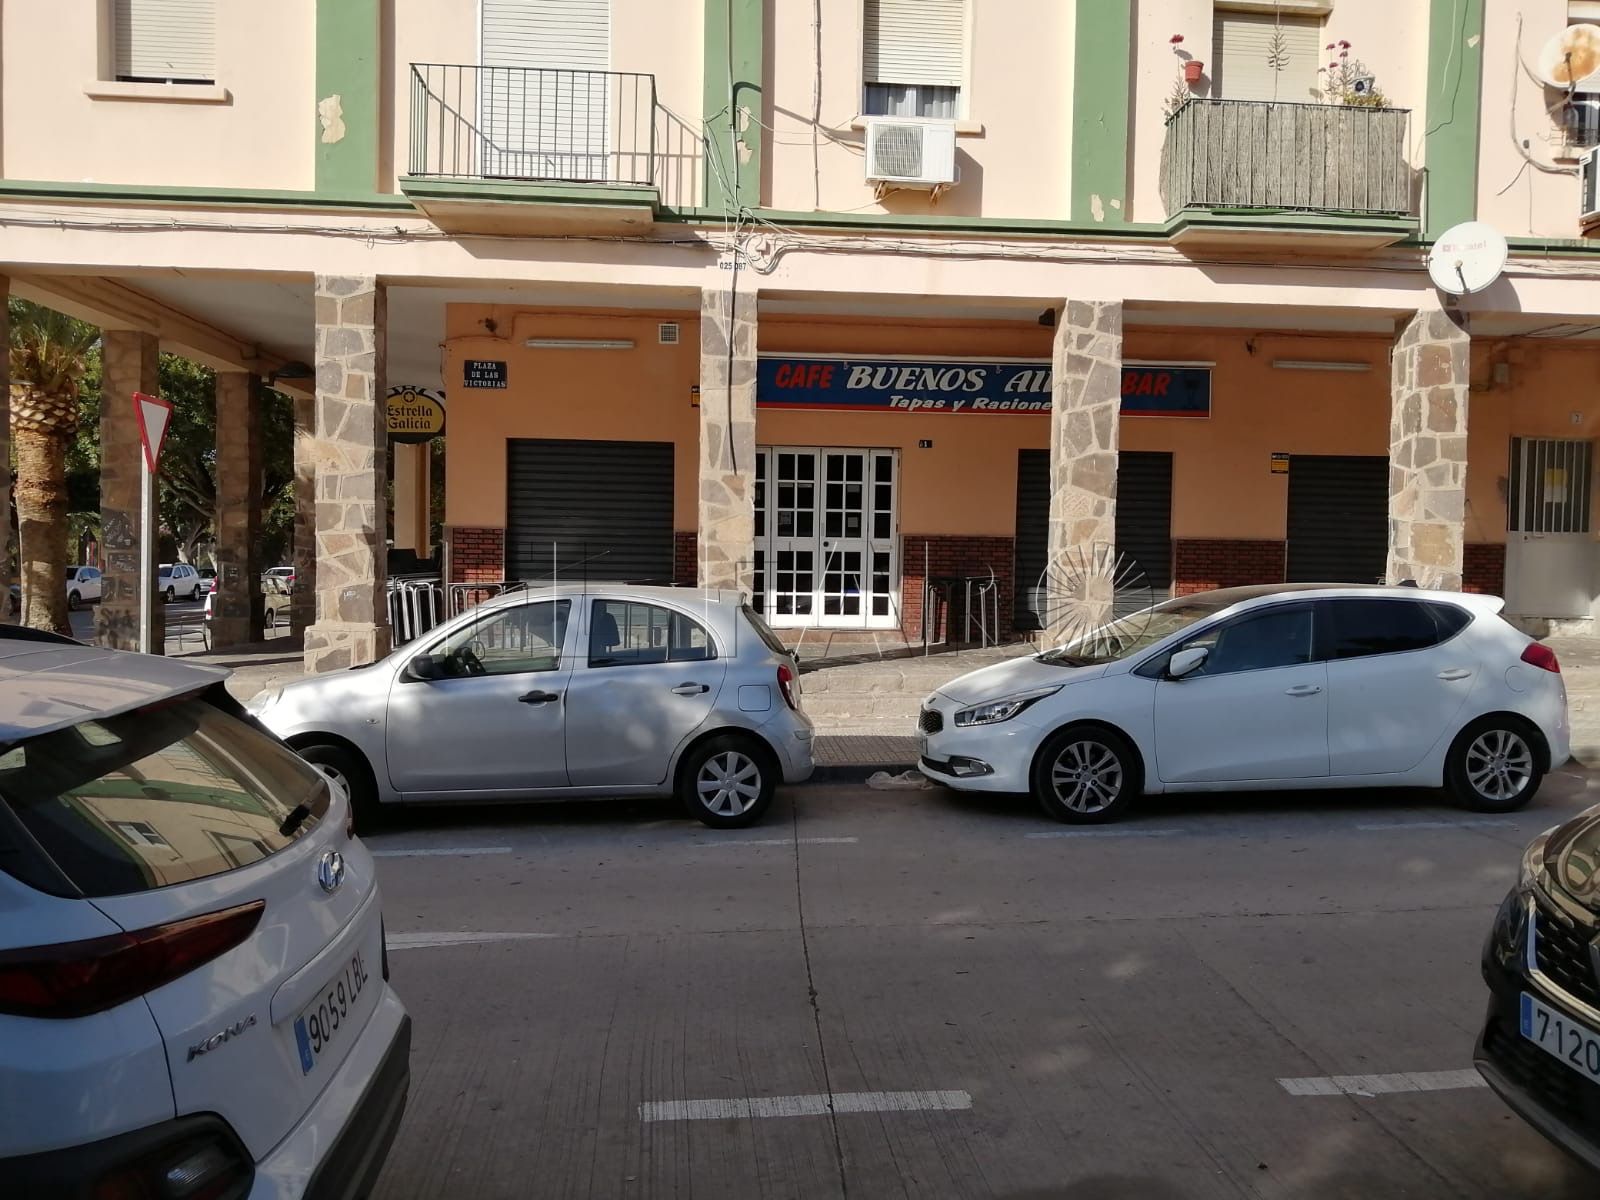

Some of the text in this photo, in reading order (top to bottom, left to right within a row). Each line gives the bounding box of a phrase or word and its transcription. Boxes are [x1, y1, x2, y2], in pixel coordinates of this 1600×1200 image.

[720, 262, 732, 270] 025
[473, 362, 496, 370] PLAZA
[485, 371, 499, 379] LAS
[775, 364, 833, 389] CAFE
[847, 366, 987, 392] BUENOS
[1120, 372, 1171, 396] BAR
[464, 380, 506, 388] VICTORIAS
[387, 405, 433, 417] Estrella
[890, 396, 1053, 412] Tapas y Racione
[388, 416, 432, 430] Galicia
[309, 951, 368, 1053] 9059 LBL
[186, 1011, 258, 1064] KONA
[1537, 1008, 1600, 1075] 7120
